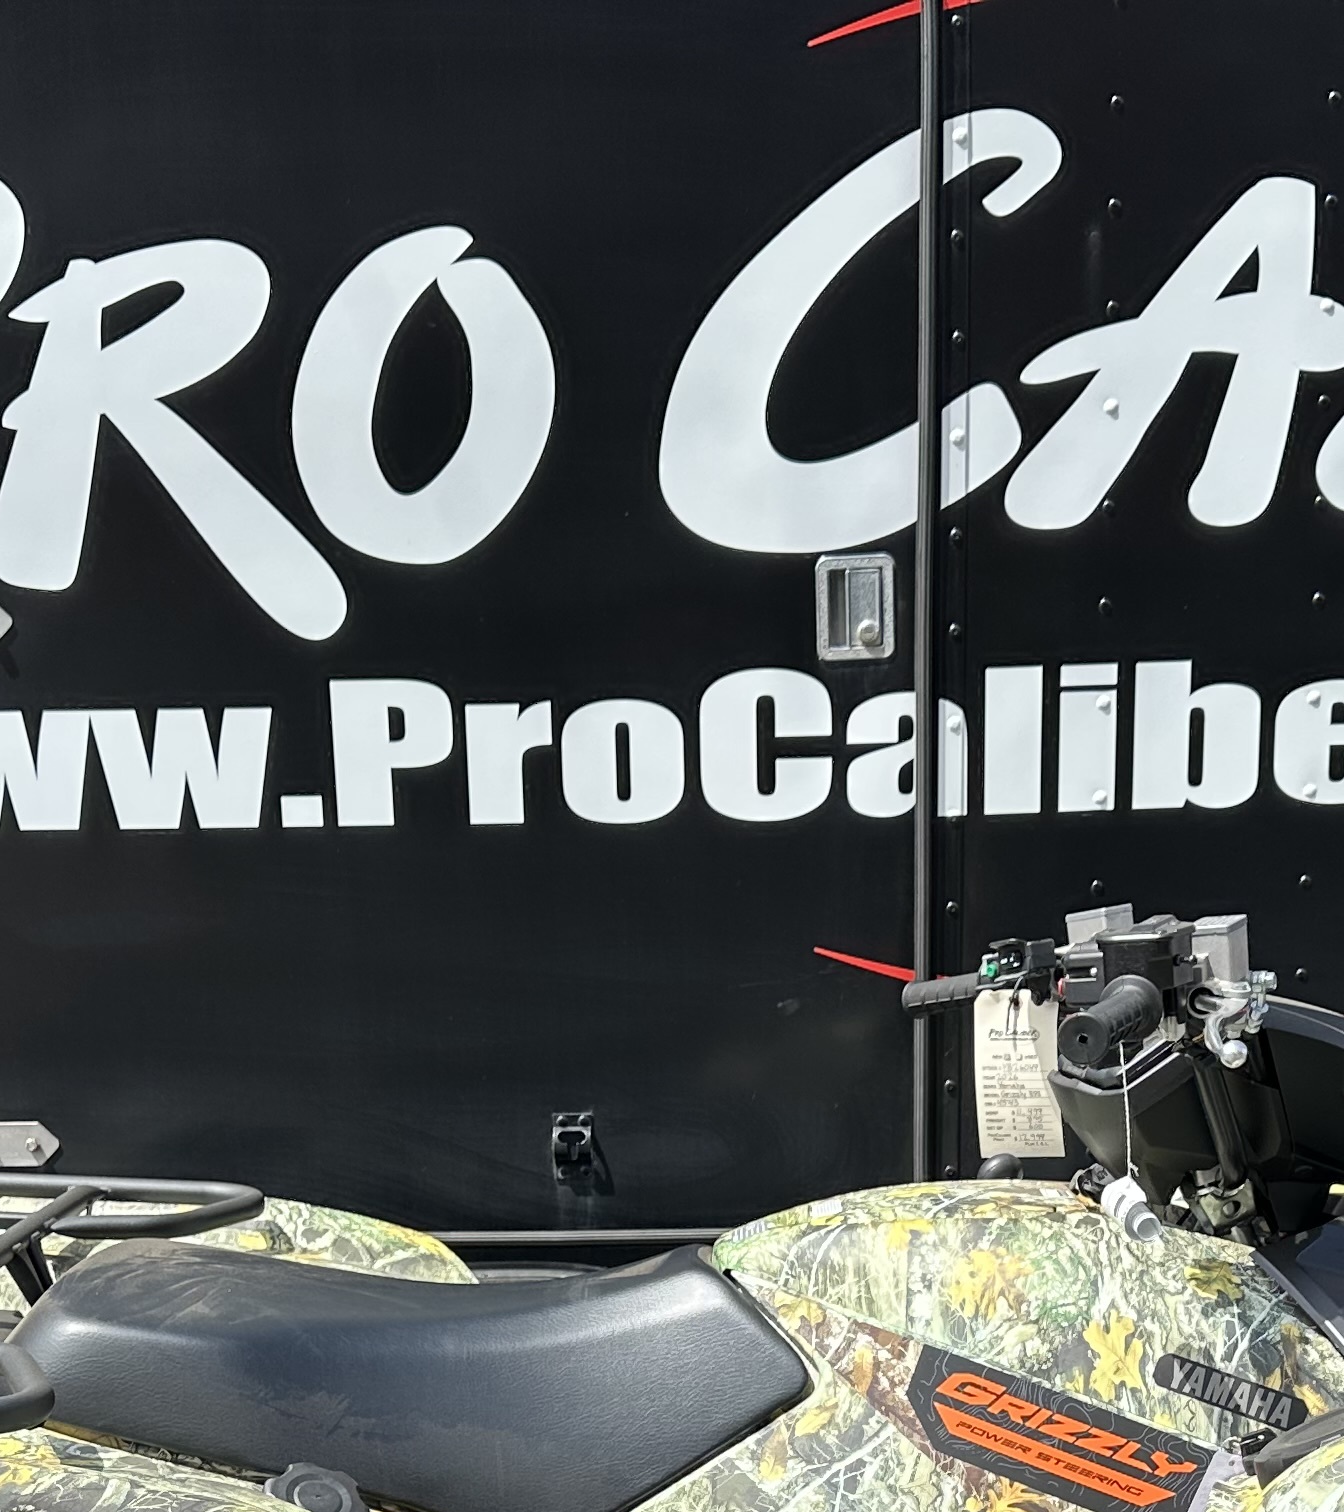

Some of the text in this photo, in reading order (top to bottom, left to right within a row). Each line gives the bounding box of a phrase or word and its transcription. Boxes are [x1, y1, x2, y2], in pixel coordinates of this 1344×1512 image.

[936, 1372, 1197, 1477] GRIZZLY
[1170, 1357, 1293, 1430] YAMAHA
[956, 1420, 1145, 1498] POWER STEERING
